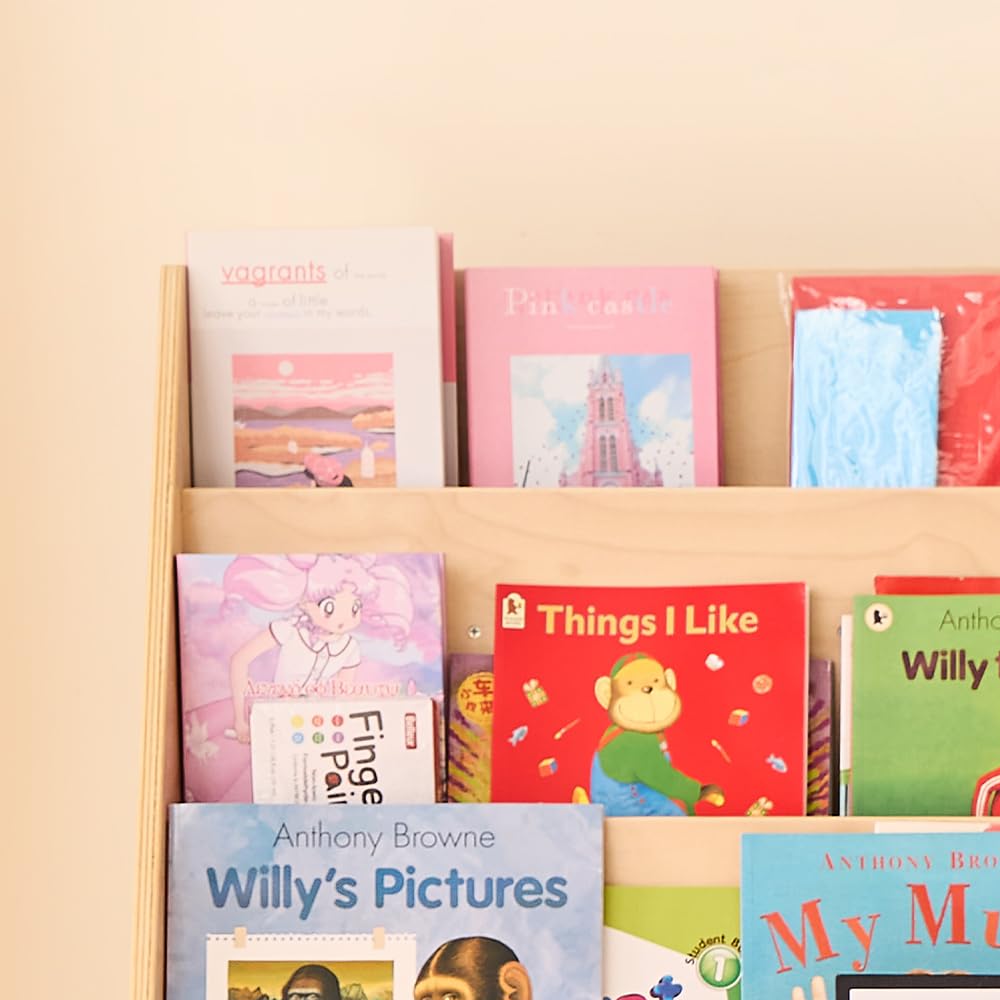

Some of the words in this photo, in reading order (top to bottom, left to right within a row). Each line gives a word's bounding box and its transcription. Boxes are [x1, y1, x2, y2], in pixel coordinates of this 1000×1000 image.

[221, 260, 327, 287] vagrants
[333, 263, 350, 280] of
[503, 287, 577, 316] Pink
[586, 287, 673, 316] castle
[537, 604, 657, 644] Things
[665, 605, 674, 635] I
[685, 604, 759, 635] Like
[902, 649, 989, 690] Willy
[272, 822, 383, 856] Anthony
[394, 823, 496, 849] Browne
[820, 851, 934, 872] ANTHONY
[206, 864, 358, 920] Willy's
[375, 865, 568, 909] Pictures
[685, 934, 725, 965] Student
[760, 898, 881, 974] My
